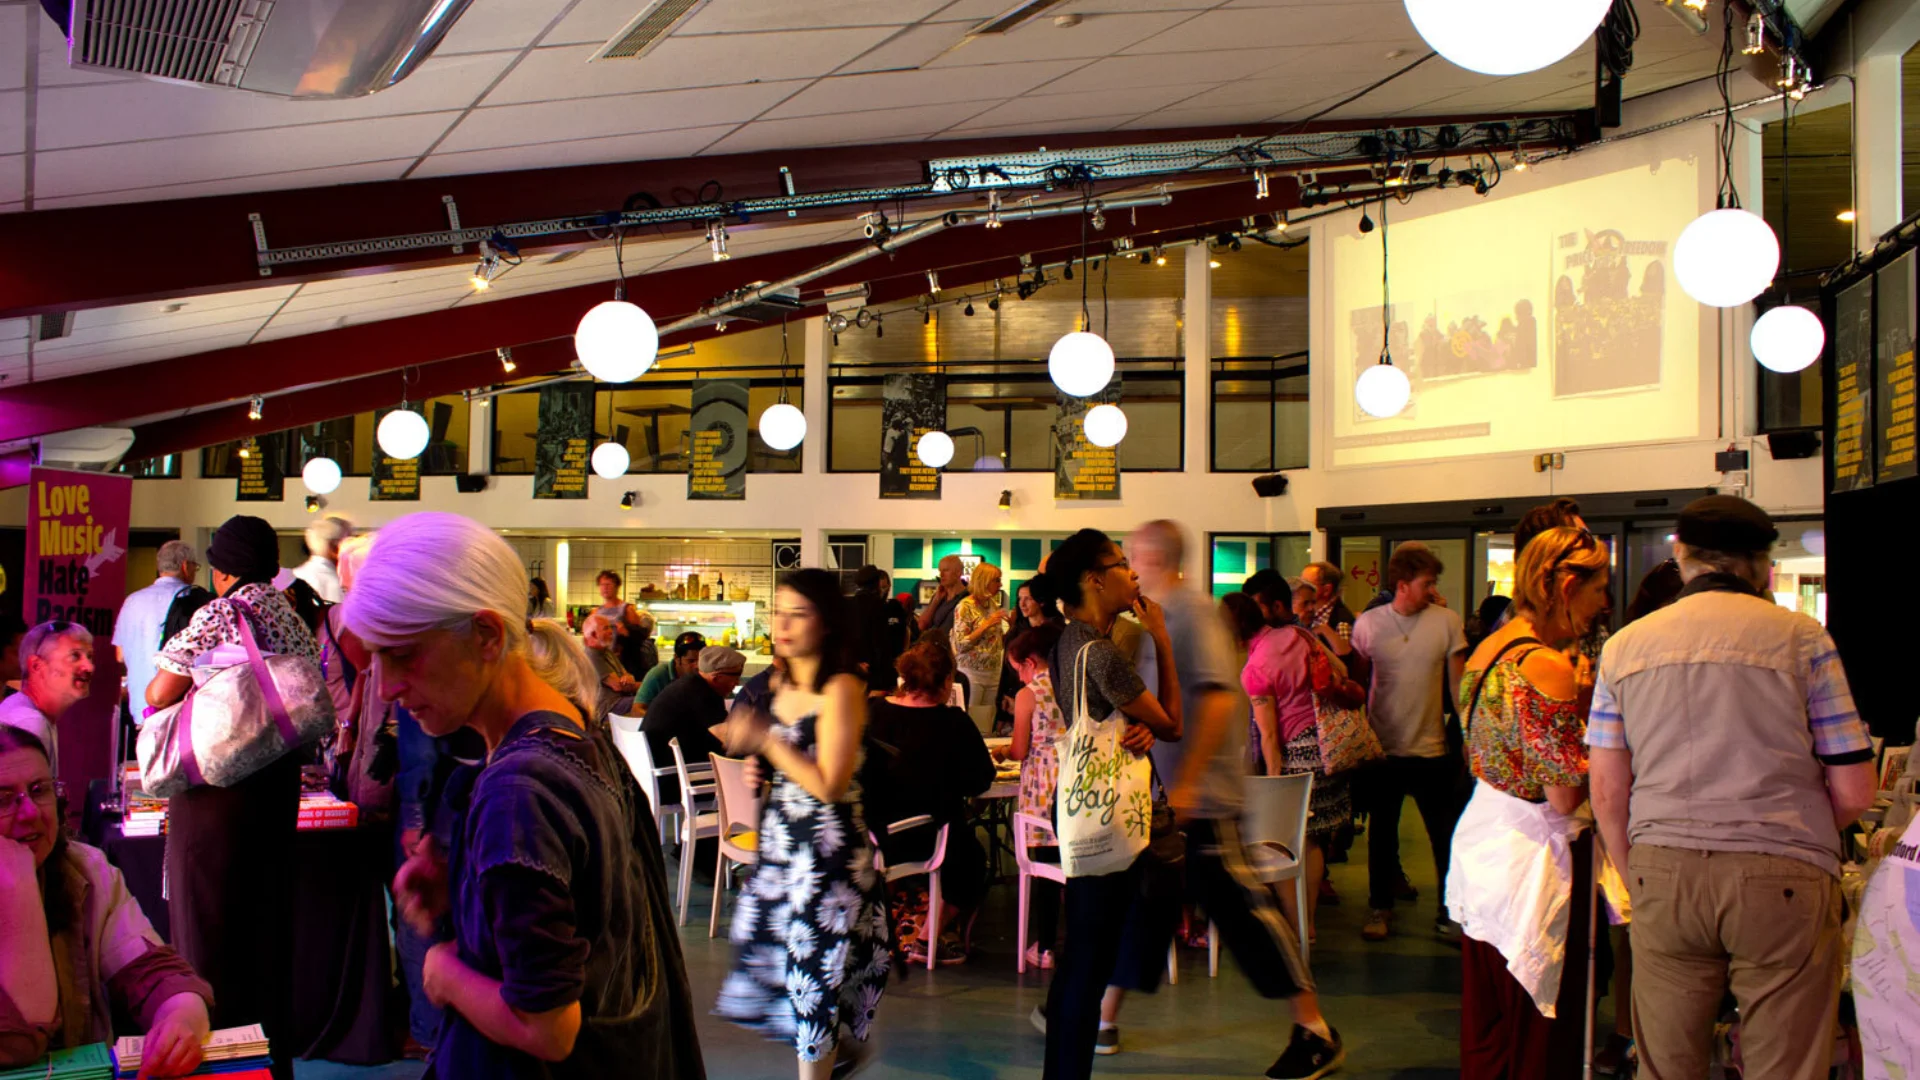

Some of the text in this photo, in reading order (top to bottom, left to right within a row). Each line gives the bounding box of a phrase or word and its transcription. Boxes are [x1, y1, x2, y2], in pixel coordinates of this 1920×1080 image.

[38, 481, 90, 517] Love
[39, 515, 104, 557] Music
[38, 558, 90, 596] Hate
[1083, 749, 1132, 791] green
[316, 810, 323, 818] OF
[1065, 774, 1120, 825] bag
[314, 819, 323, 827] OF
